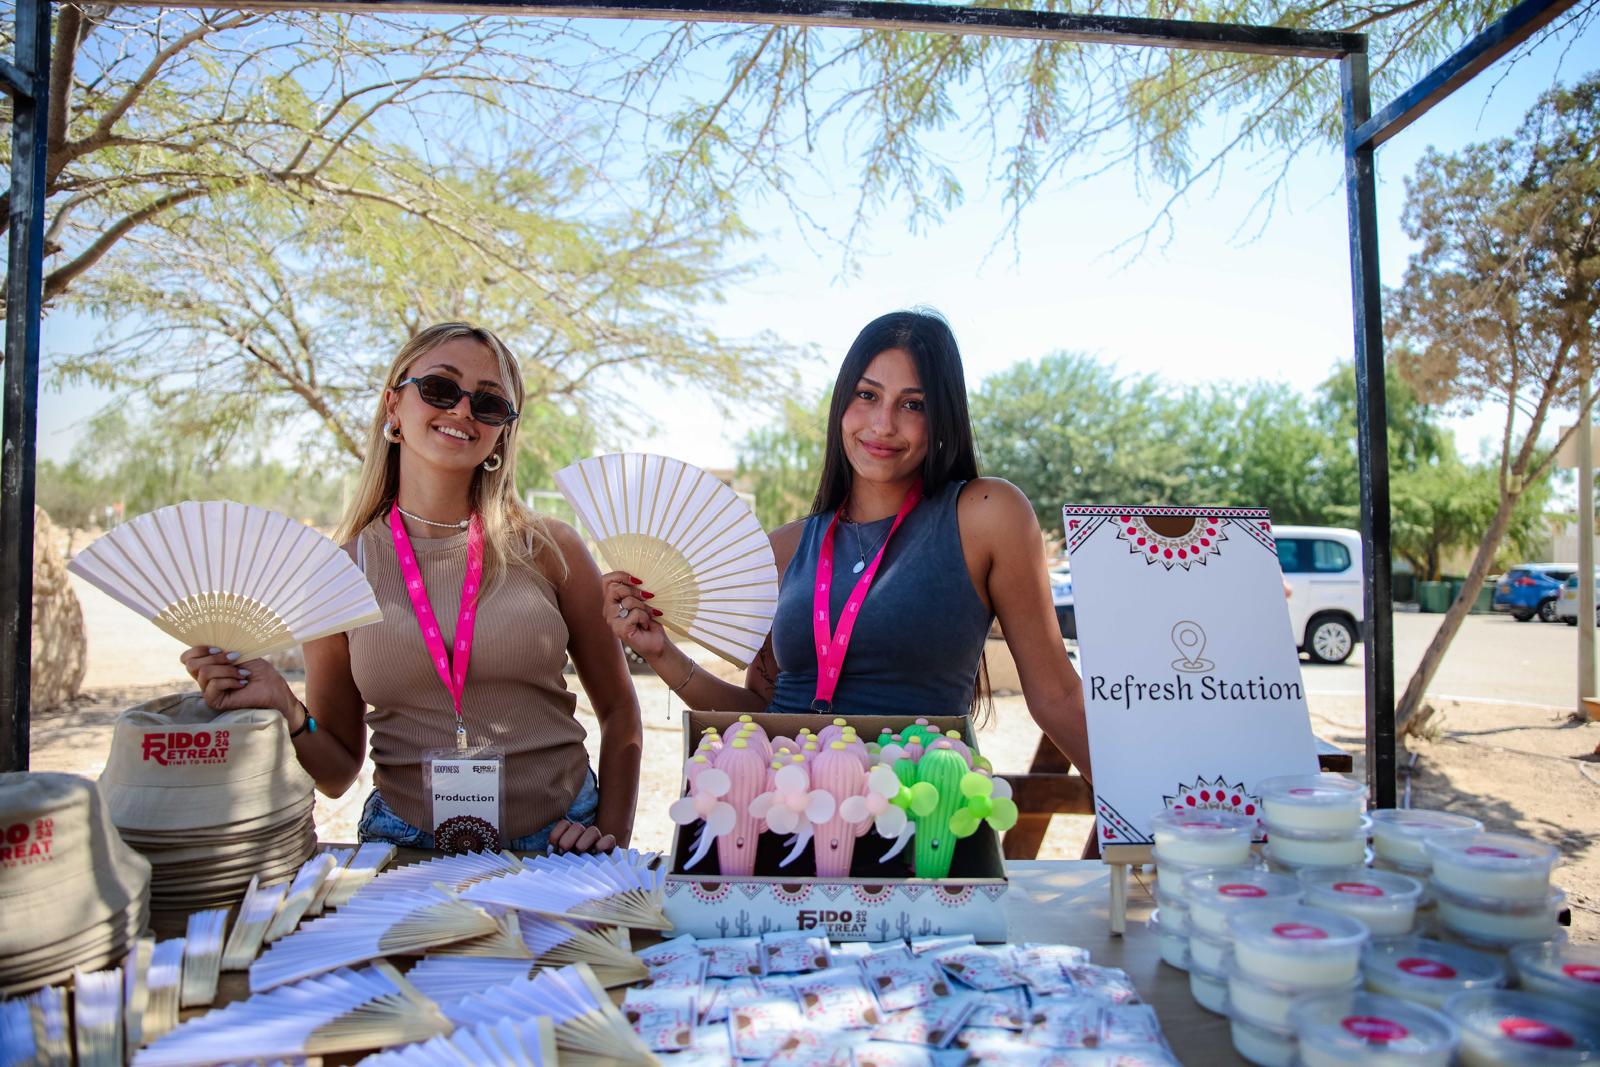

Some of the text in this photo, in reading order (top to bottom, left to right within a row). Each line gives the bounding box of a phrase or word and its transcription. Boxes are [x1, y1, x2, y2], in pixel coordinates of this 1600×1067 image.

[1090, 674, 1303, 710] Refresh Station
[215, 730, 230, 738] 20
[142, 744, 229, 766] RETREAT
[434, 794, 495, 802] Production
[0, 823, 30, 845] O
